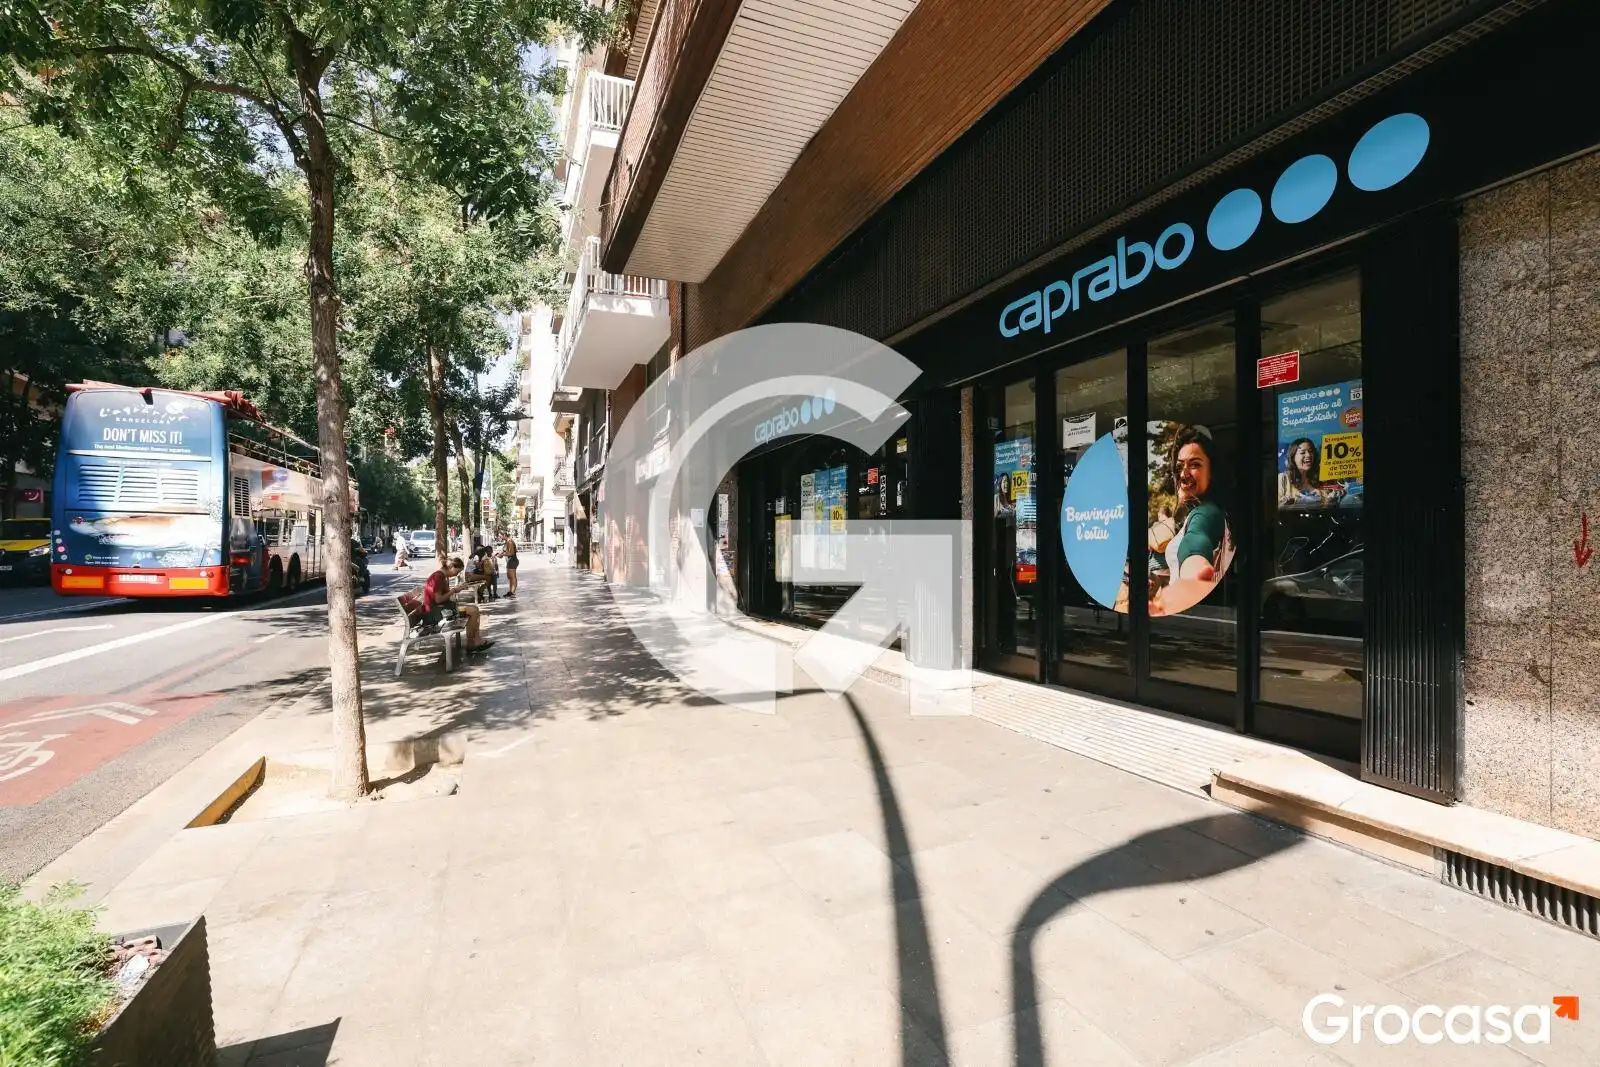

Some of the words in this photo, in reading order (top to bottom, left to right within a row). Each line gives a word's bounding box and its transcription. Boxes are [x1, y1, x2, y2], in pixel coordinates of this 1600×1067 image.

[999, 222, 1195, 338] caprabo
[1282, 392, 1317, 405] caprabo
[1331, 398, 1343, 408] al
[754, 406, 799, 444] caprabo
[103, 427, 137, 442] DON'T
[139, 429, 167, 444] MISS
[169, 431, 183, 445] IT!
[1324, 442, 1362, 460] 10%
[1065, 504, 1125, 525] Benvingut
